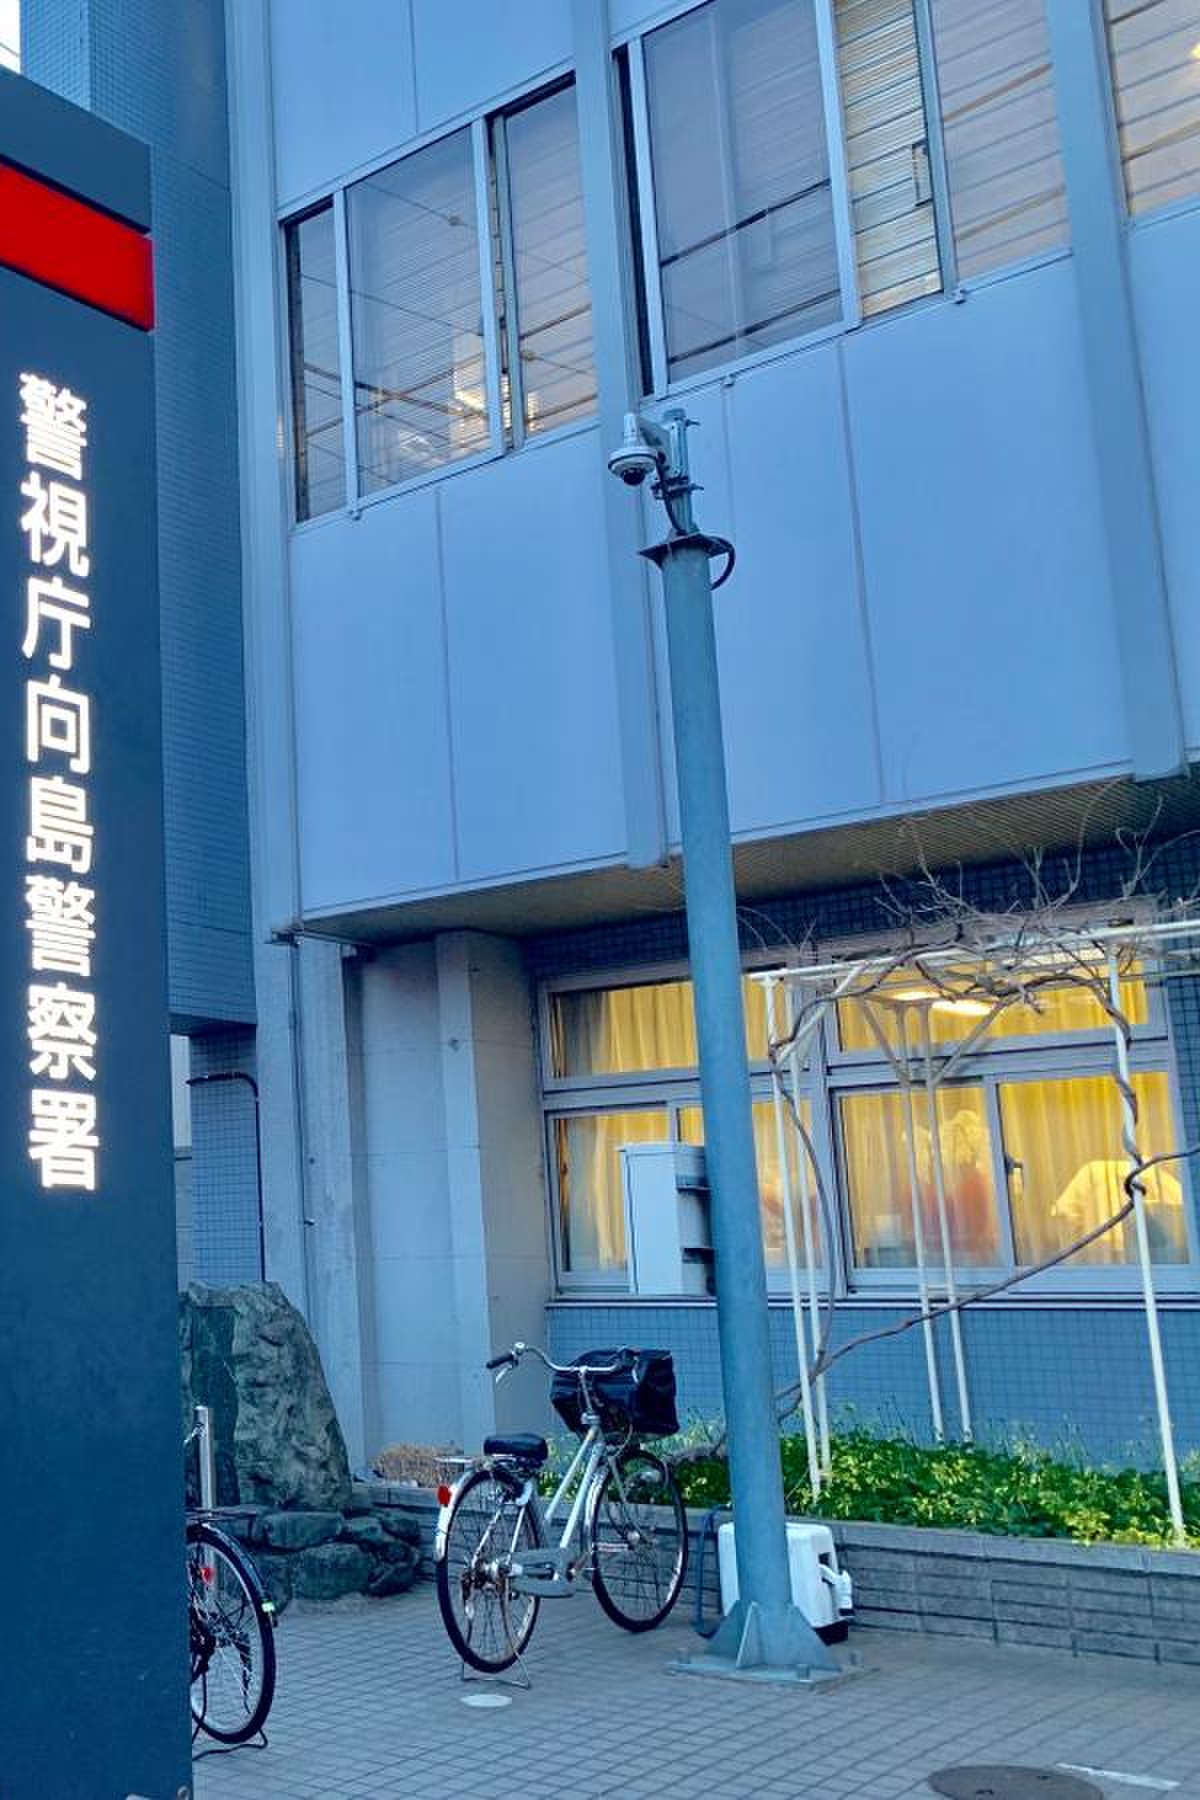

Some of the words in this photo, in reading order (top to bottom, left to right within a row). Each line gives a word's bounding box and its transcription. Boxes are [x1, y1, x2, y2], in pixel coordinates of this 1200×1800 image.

[19, 372, 99, 1192] 警視庁向島警察署
